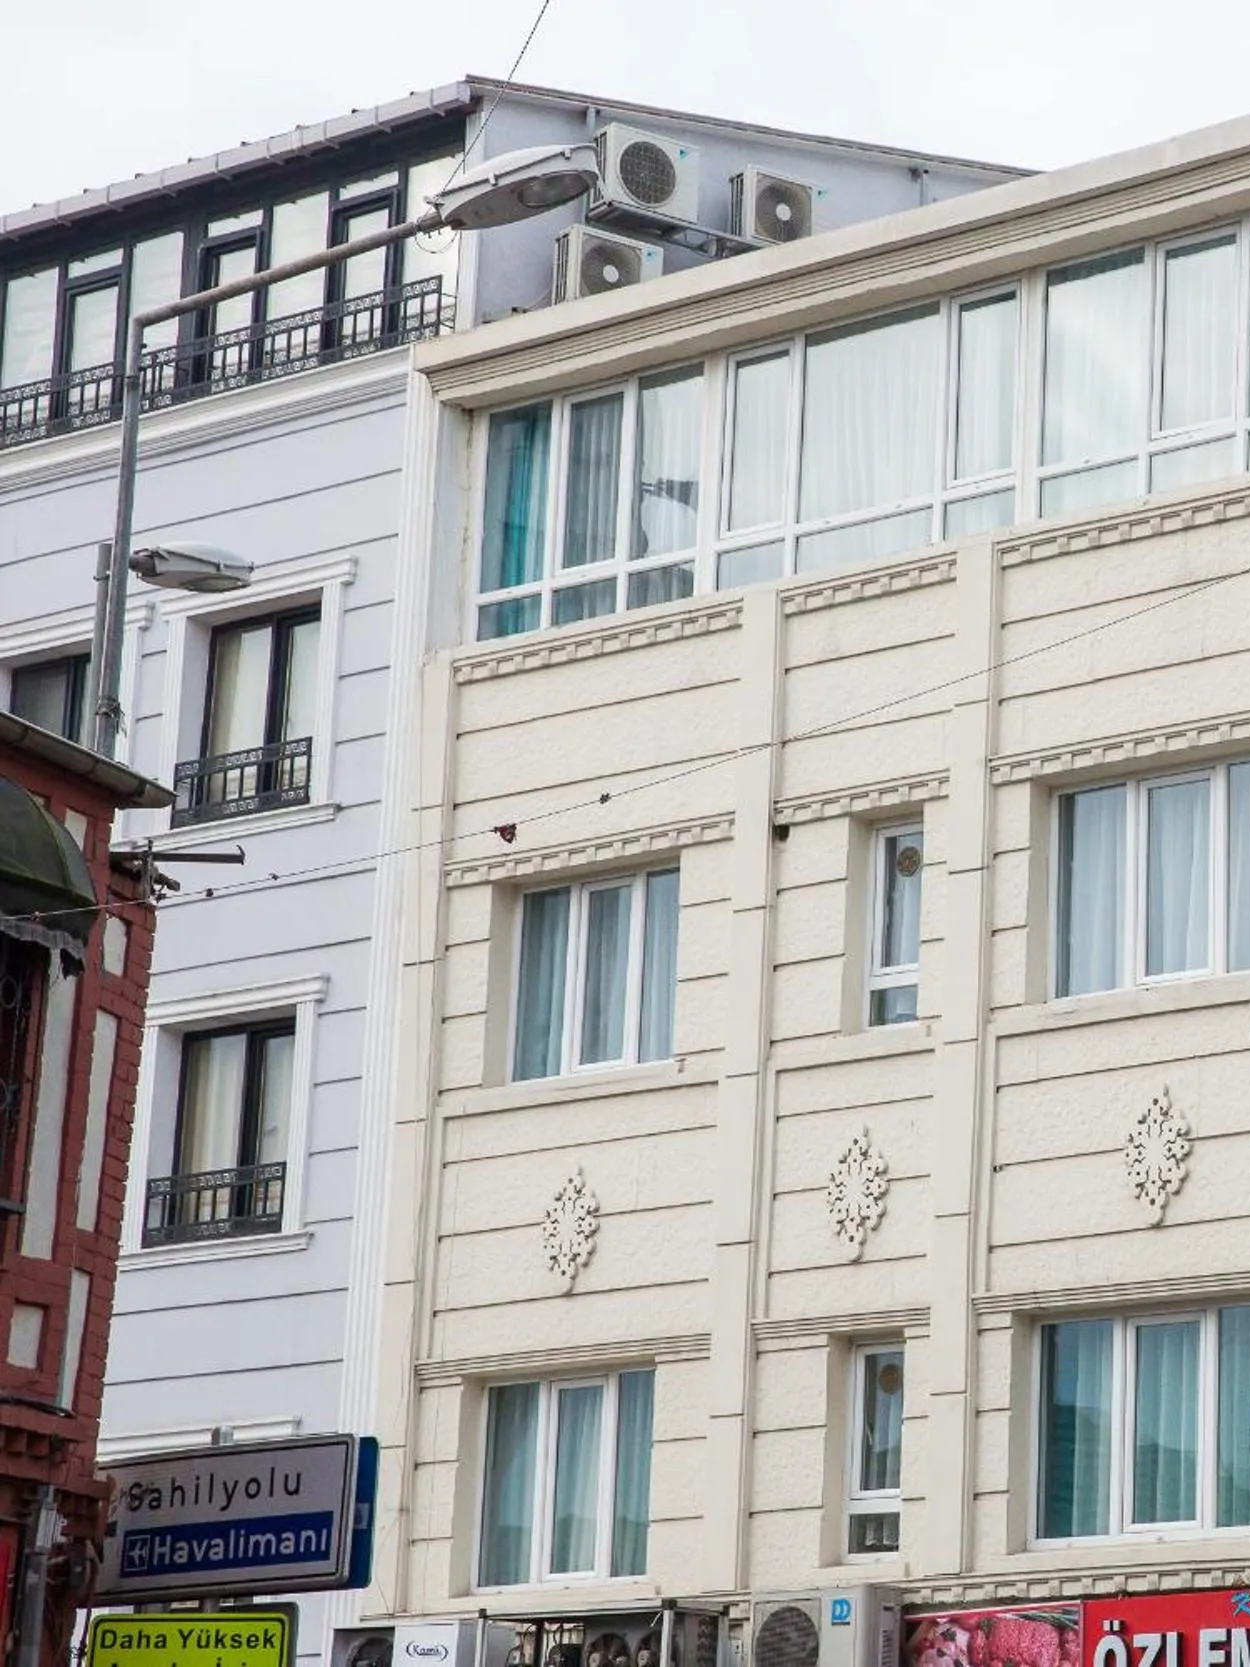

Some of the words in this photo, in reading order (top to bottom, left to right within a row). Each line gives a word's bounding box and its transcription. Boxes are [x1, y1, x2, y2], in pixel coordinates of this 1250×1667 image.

[127, 1466, 302, 1513] Sahilyolu
[152, 1527, 328, 1567] Havalimanı
[101, 1629, 167, 1650] Daha
[178, 1628, 276, 1650] Yüksek
